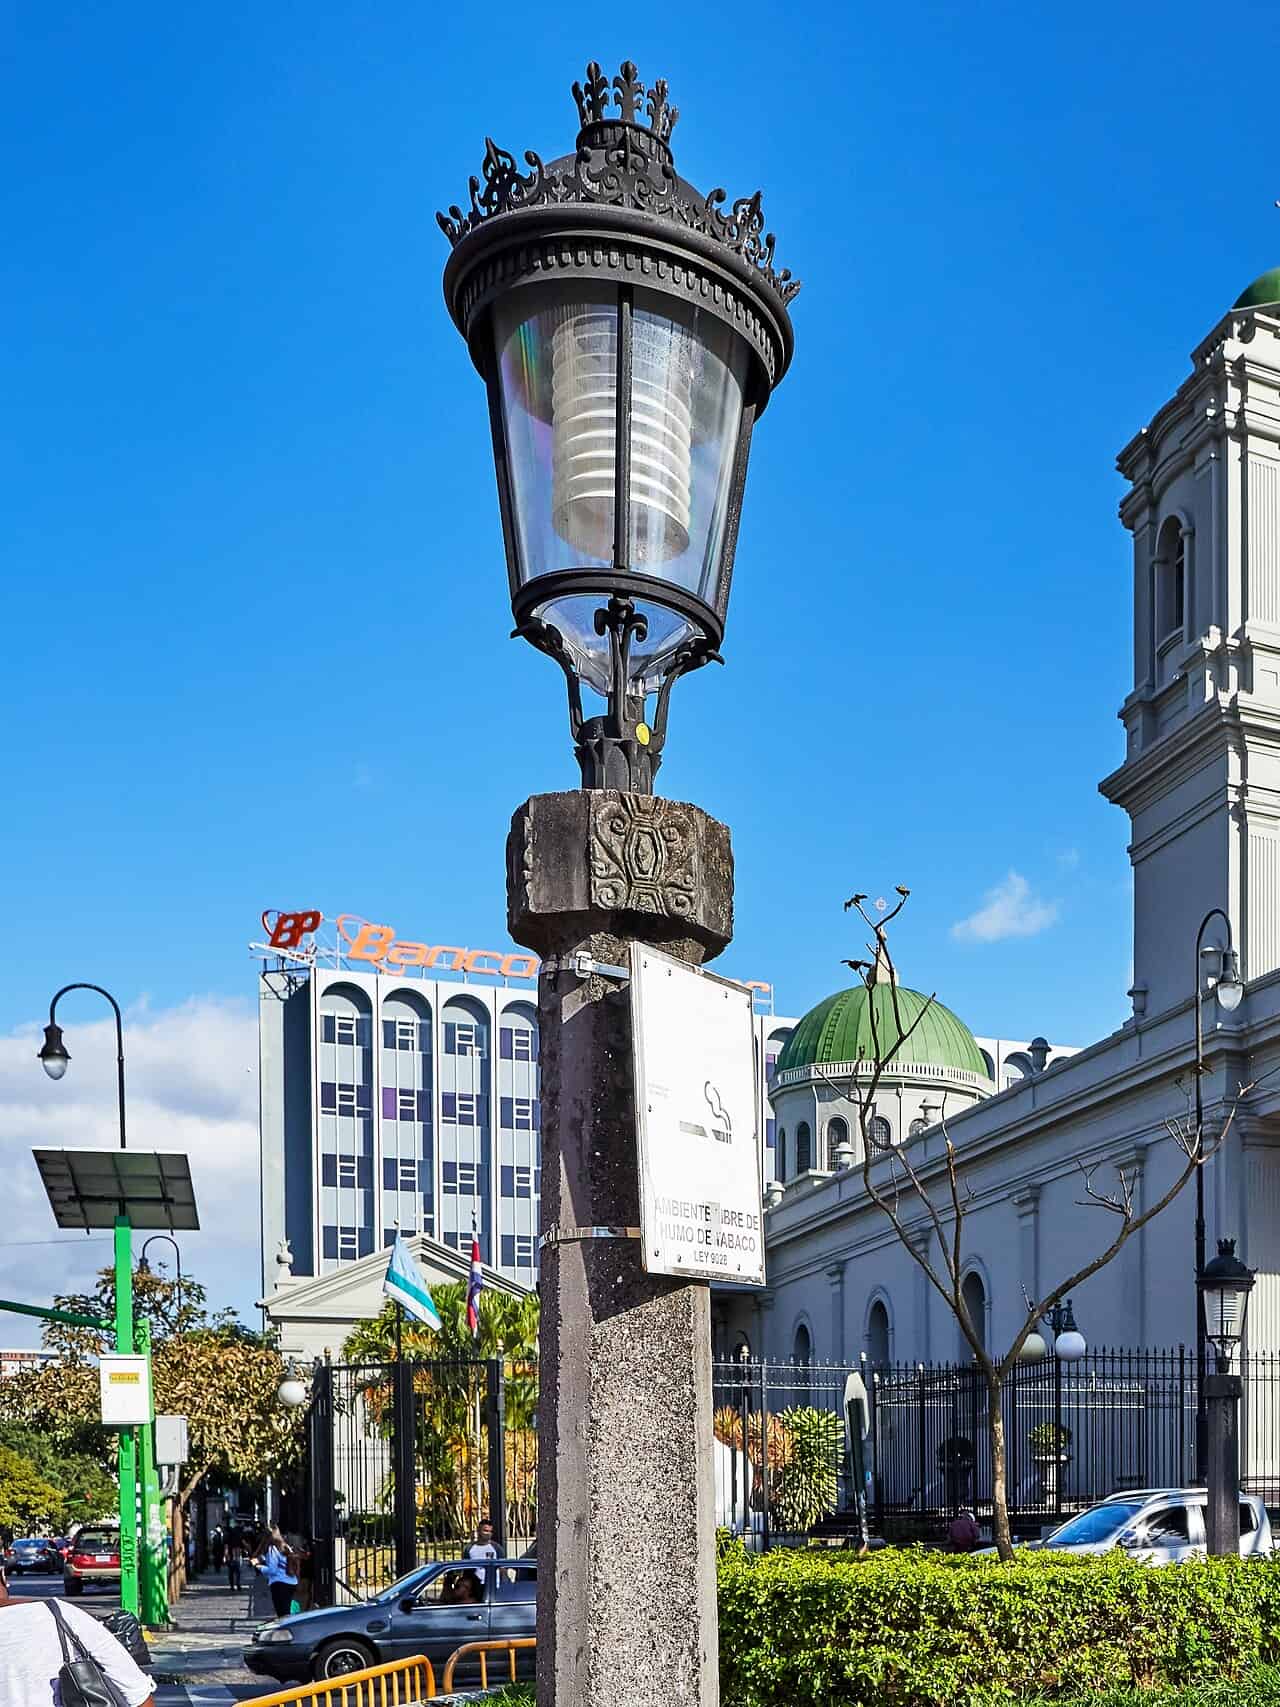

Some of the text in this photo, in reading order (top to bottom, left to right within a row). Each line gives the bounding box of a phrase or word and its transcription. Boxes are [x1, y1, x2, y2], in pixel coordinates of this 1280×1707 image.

[264, 910, 322, 950] BP
[342, 916, 539, 978] Banco
[655, 1197, 759, 1231] AMBIENTE IBRE DE
[660, 1222, 694, 1243] HUMO
[697, 1228, 712, 1246] DE
[694, 1250, 728, 1266] LEY 9028
